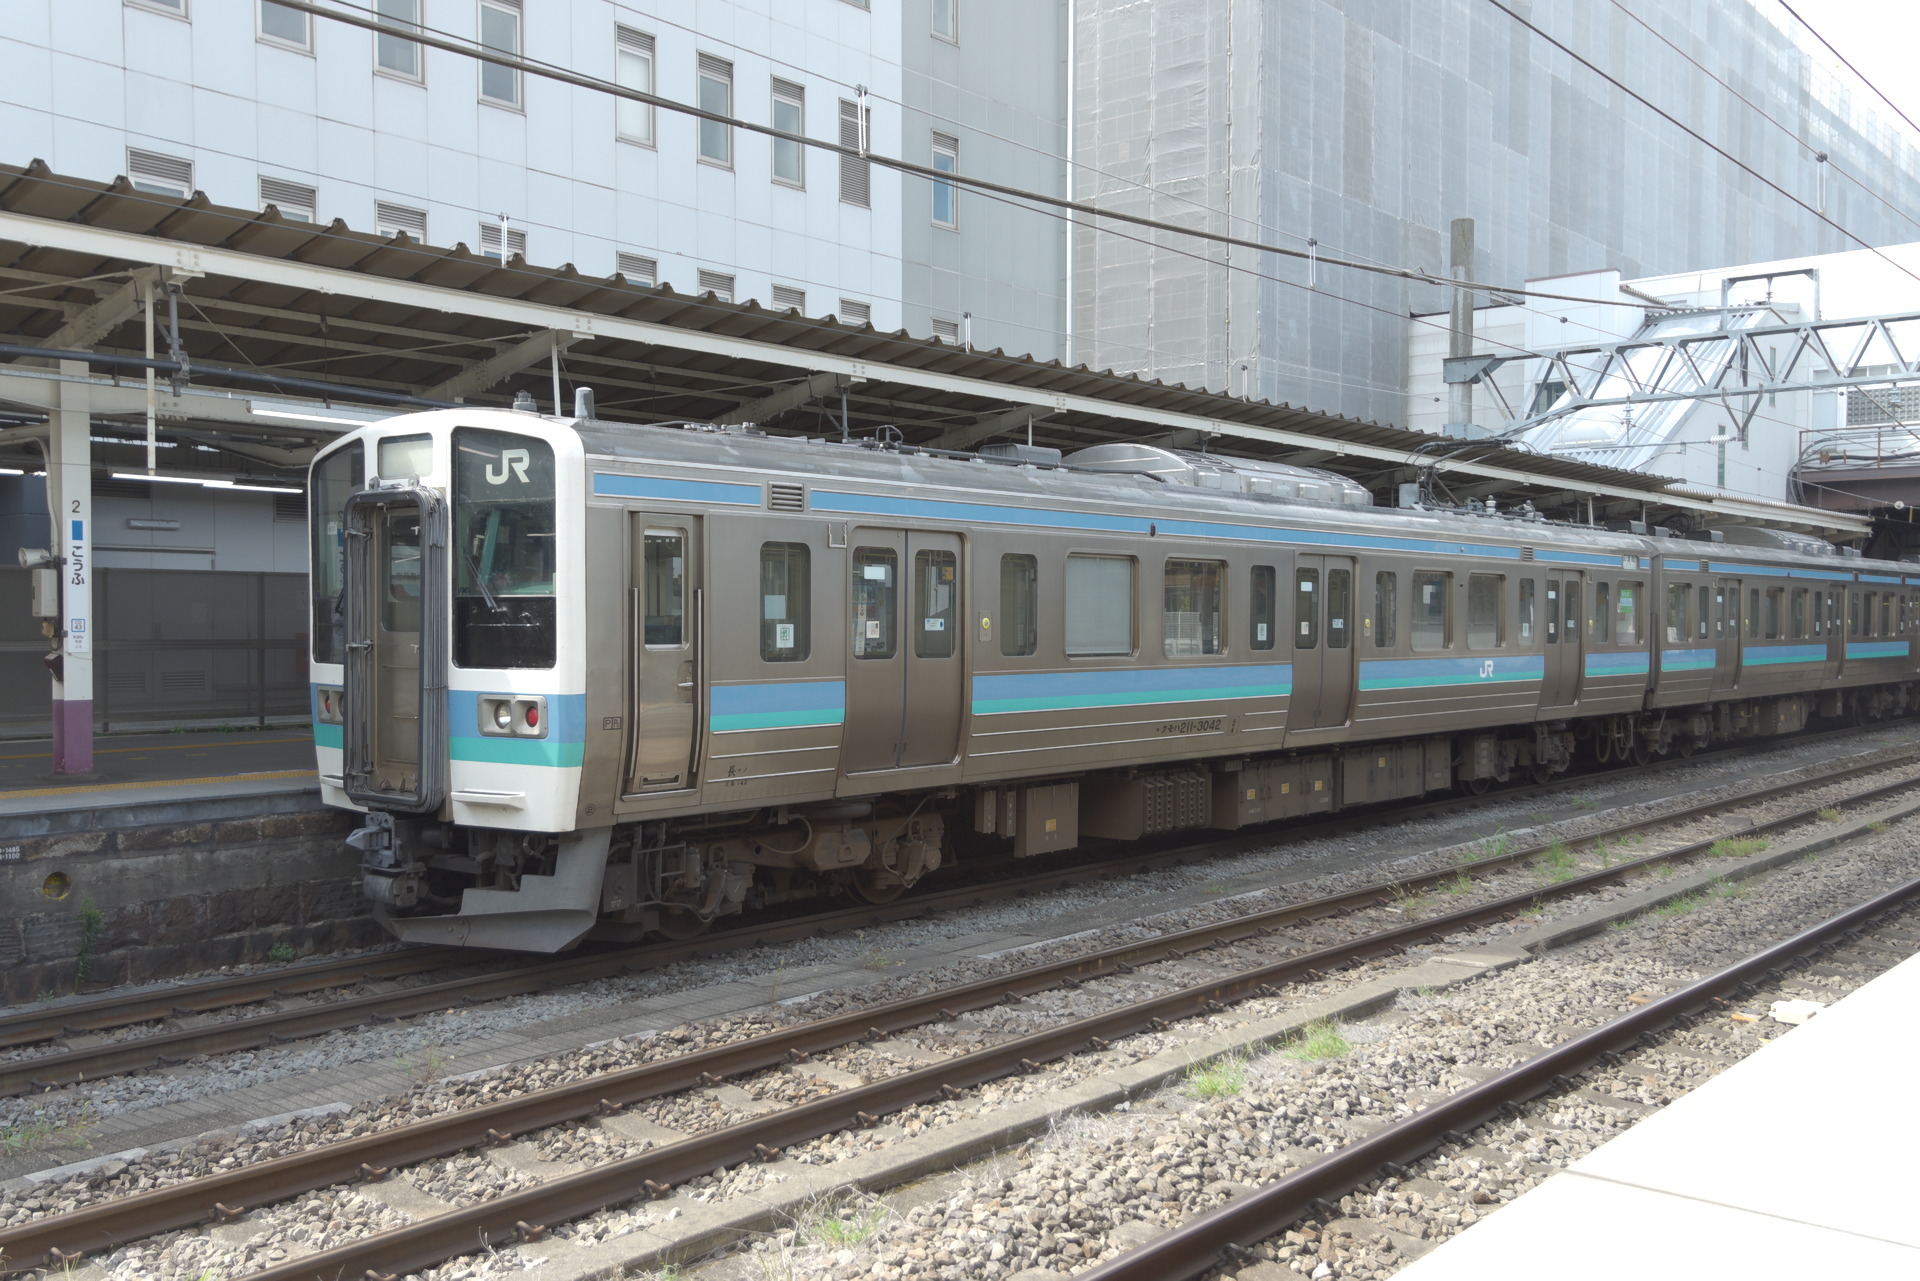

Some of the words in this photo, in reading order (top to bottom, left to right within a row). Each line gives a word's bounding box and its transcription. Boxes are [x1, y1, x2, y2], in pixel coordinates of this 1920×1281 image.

[486, 448, 530, 485] JR
[71, 500, 81, 513] 2
[71, 545, 85, 586] こうふ
[1480, 660, 1494, 678] JR
